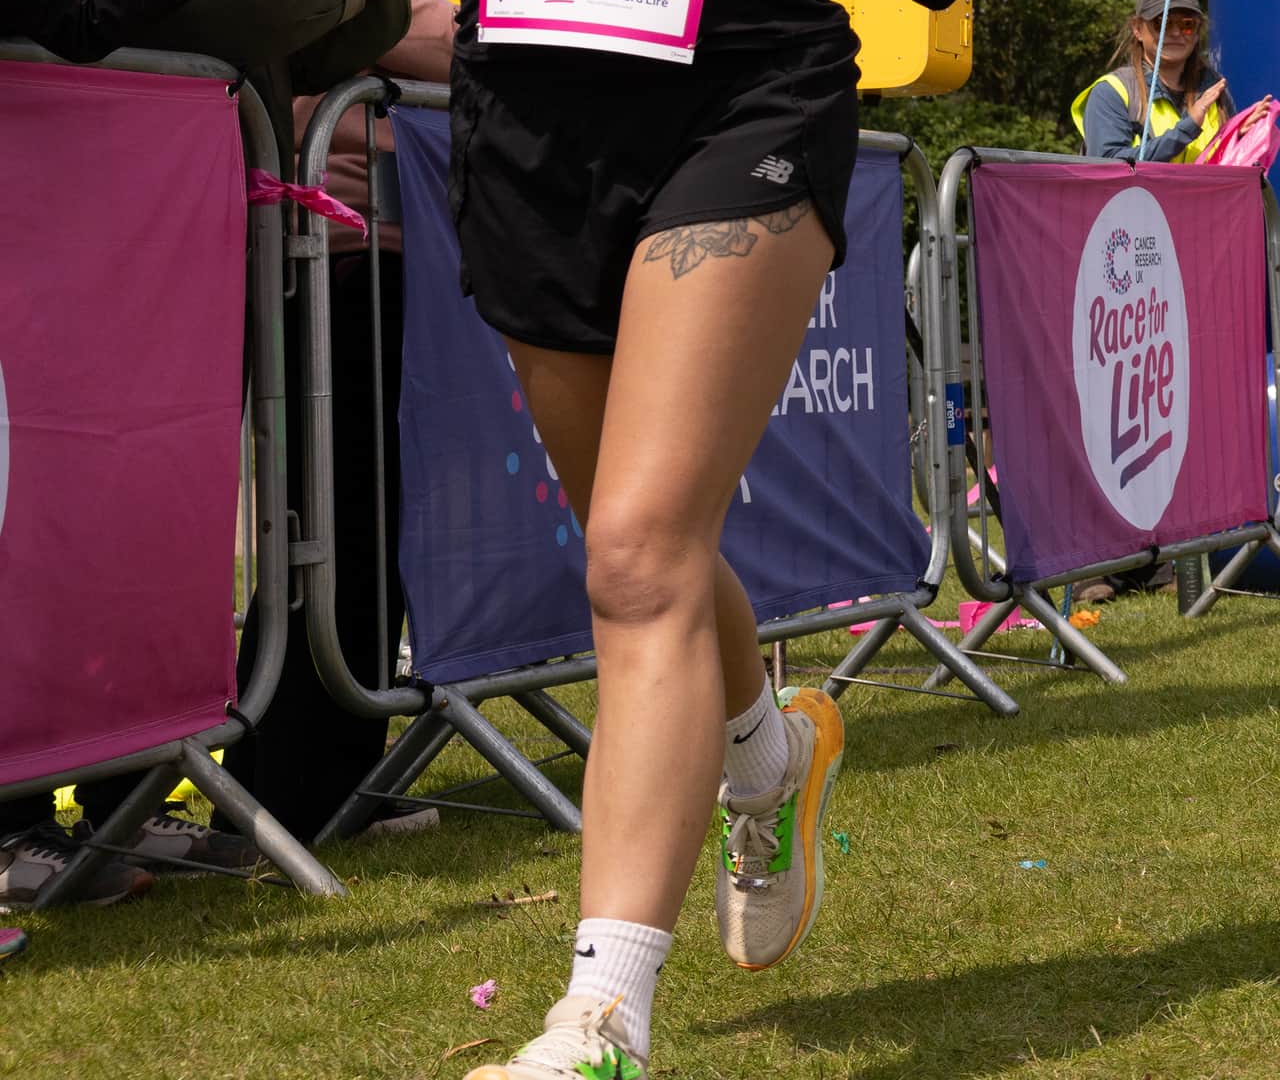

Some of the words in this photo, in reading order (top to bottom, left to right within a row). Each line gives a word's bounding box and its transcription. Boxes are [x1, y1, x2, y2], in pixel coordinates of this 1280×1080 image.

[1134, 236, 1156, 250] CANCER
[1134, 252, 1162, 266] RESEARCH
[1089, 295, 1146, 367] Race
[1148, 286, 1168, 339] for
[771, 347, 874, 416] ARCH
[1111, 340, 1174, 464] Life
[946, 400, 955, 429] arena
